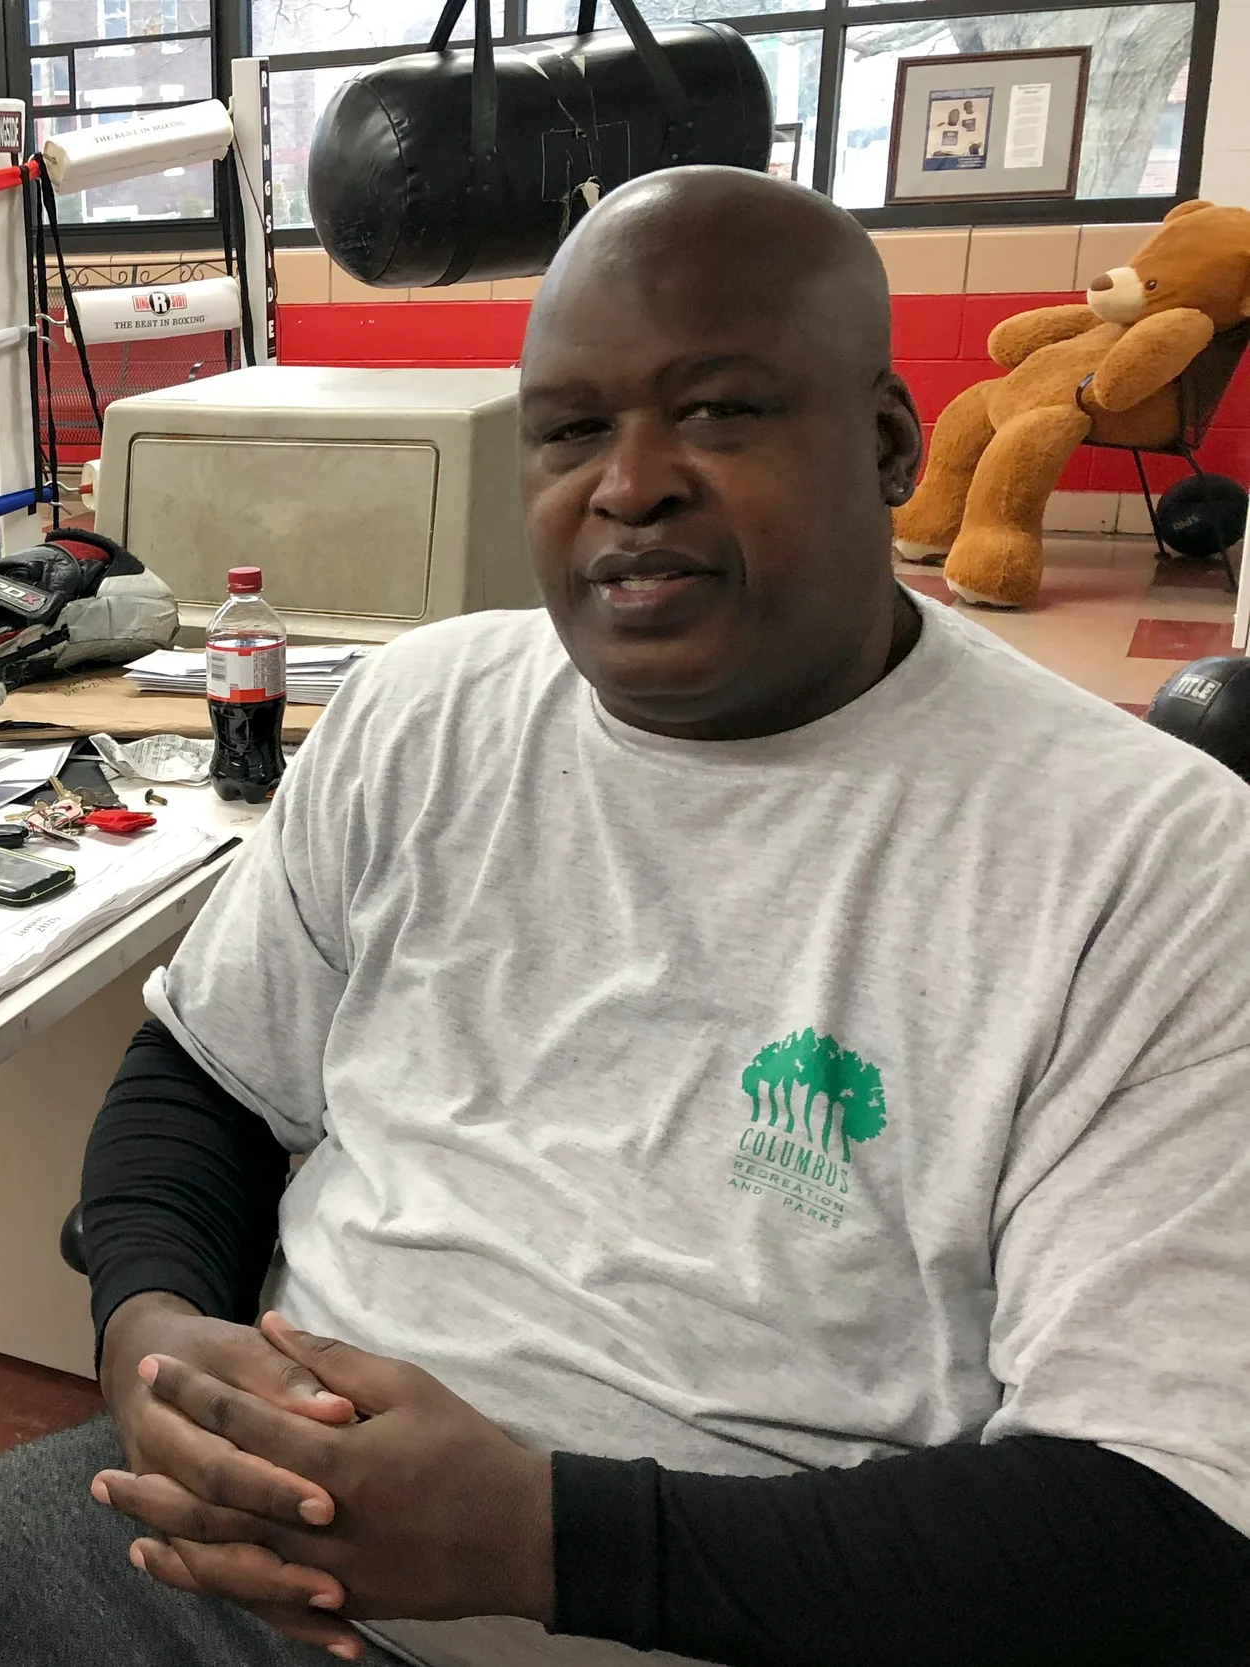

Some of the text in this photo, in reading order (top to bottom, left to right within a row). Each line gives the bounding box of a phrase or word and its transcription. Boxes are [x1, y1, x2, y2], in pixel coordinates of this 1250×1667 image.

[94, 120, 186, 144] THE BEST IN BOXING
[170, 293, 186, 309] SIDE
[114, 315, 205, 330] THE BEST IN BOXING
[1172, 675, 1216, 702] TITLE
[739, 1128, 849, 1195] COLUMBUS
[733, 1160, 845, 1213] RECREATION
[728, 1177, 841, 1230] AND PARKS
